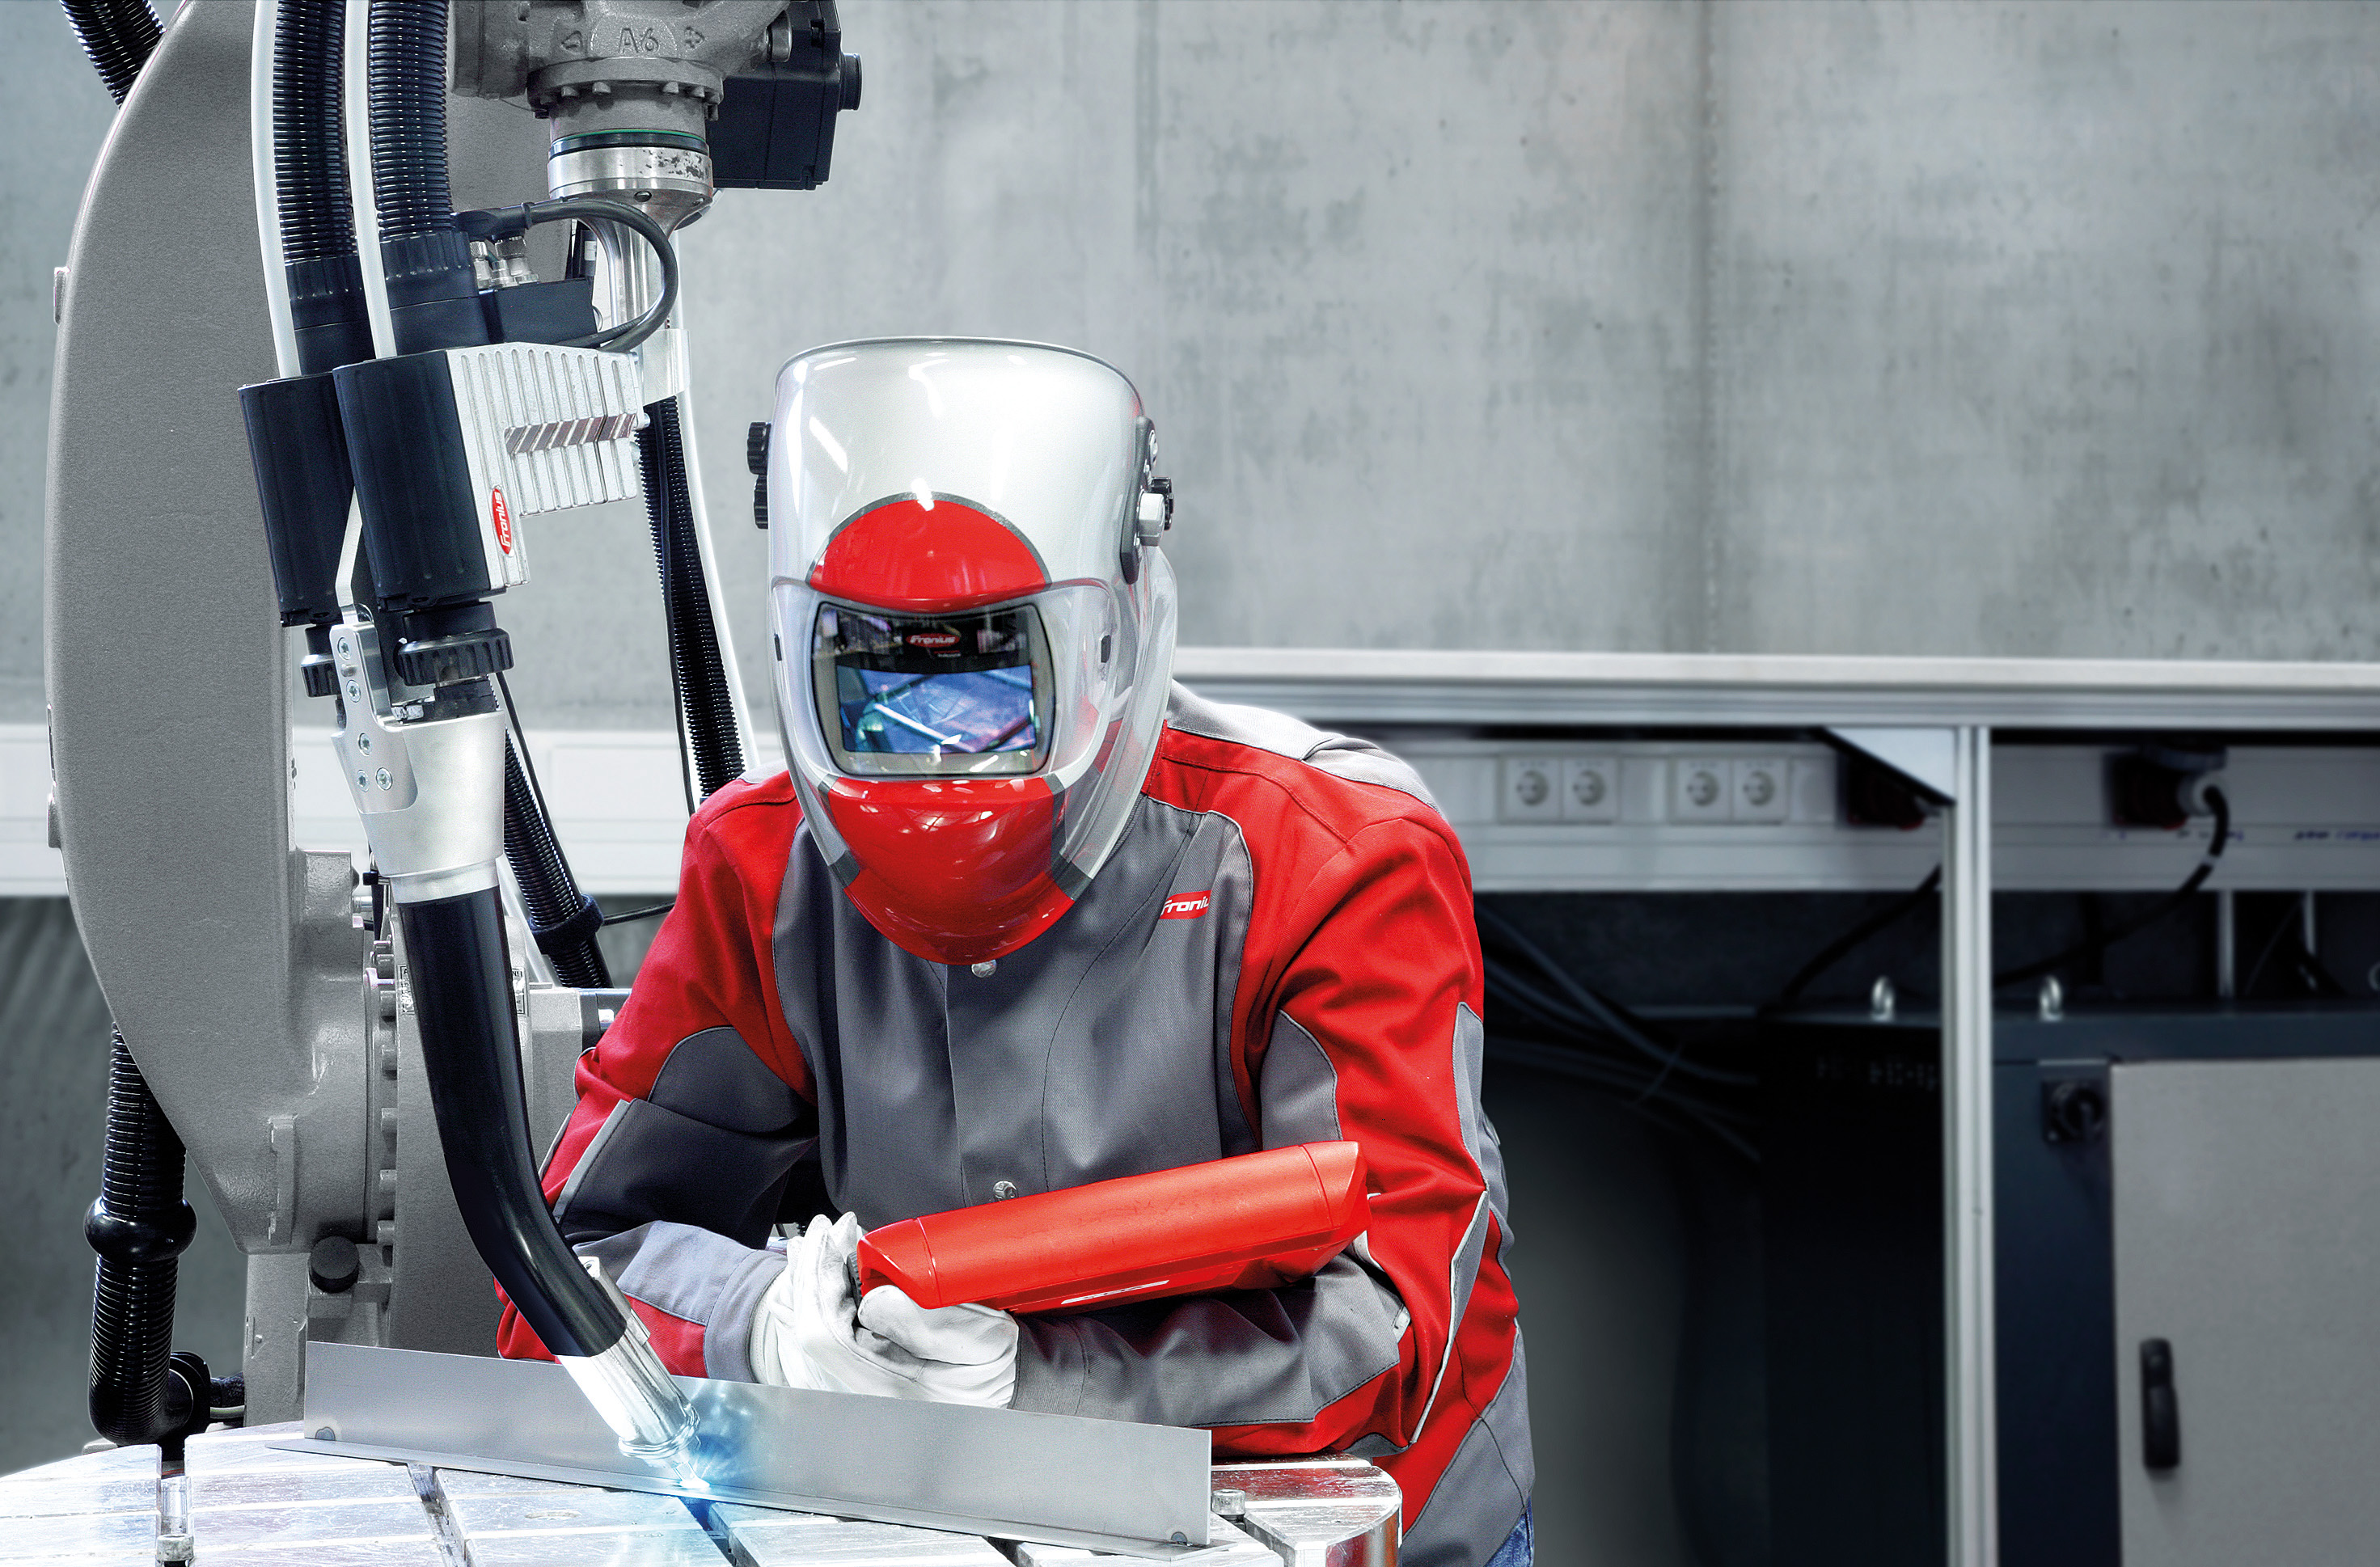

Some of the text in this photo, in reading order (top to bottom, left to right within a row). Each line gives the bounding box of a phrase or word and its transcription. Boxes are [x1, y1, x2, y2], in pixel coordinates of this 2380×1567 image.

[618, 27, 659, 53] A6
[494, 491, 511, 547] Fronius
[910, 635, 955, 644] Fronius
[1160, 896, 1210, 917] Froni
